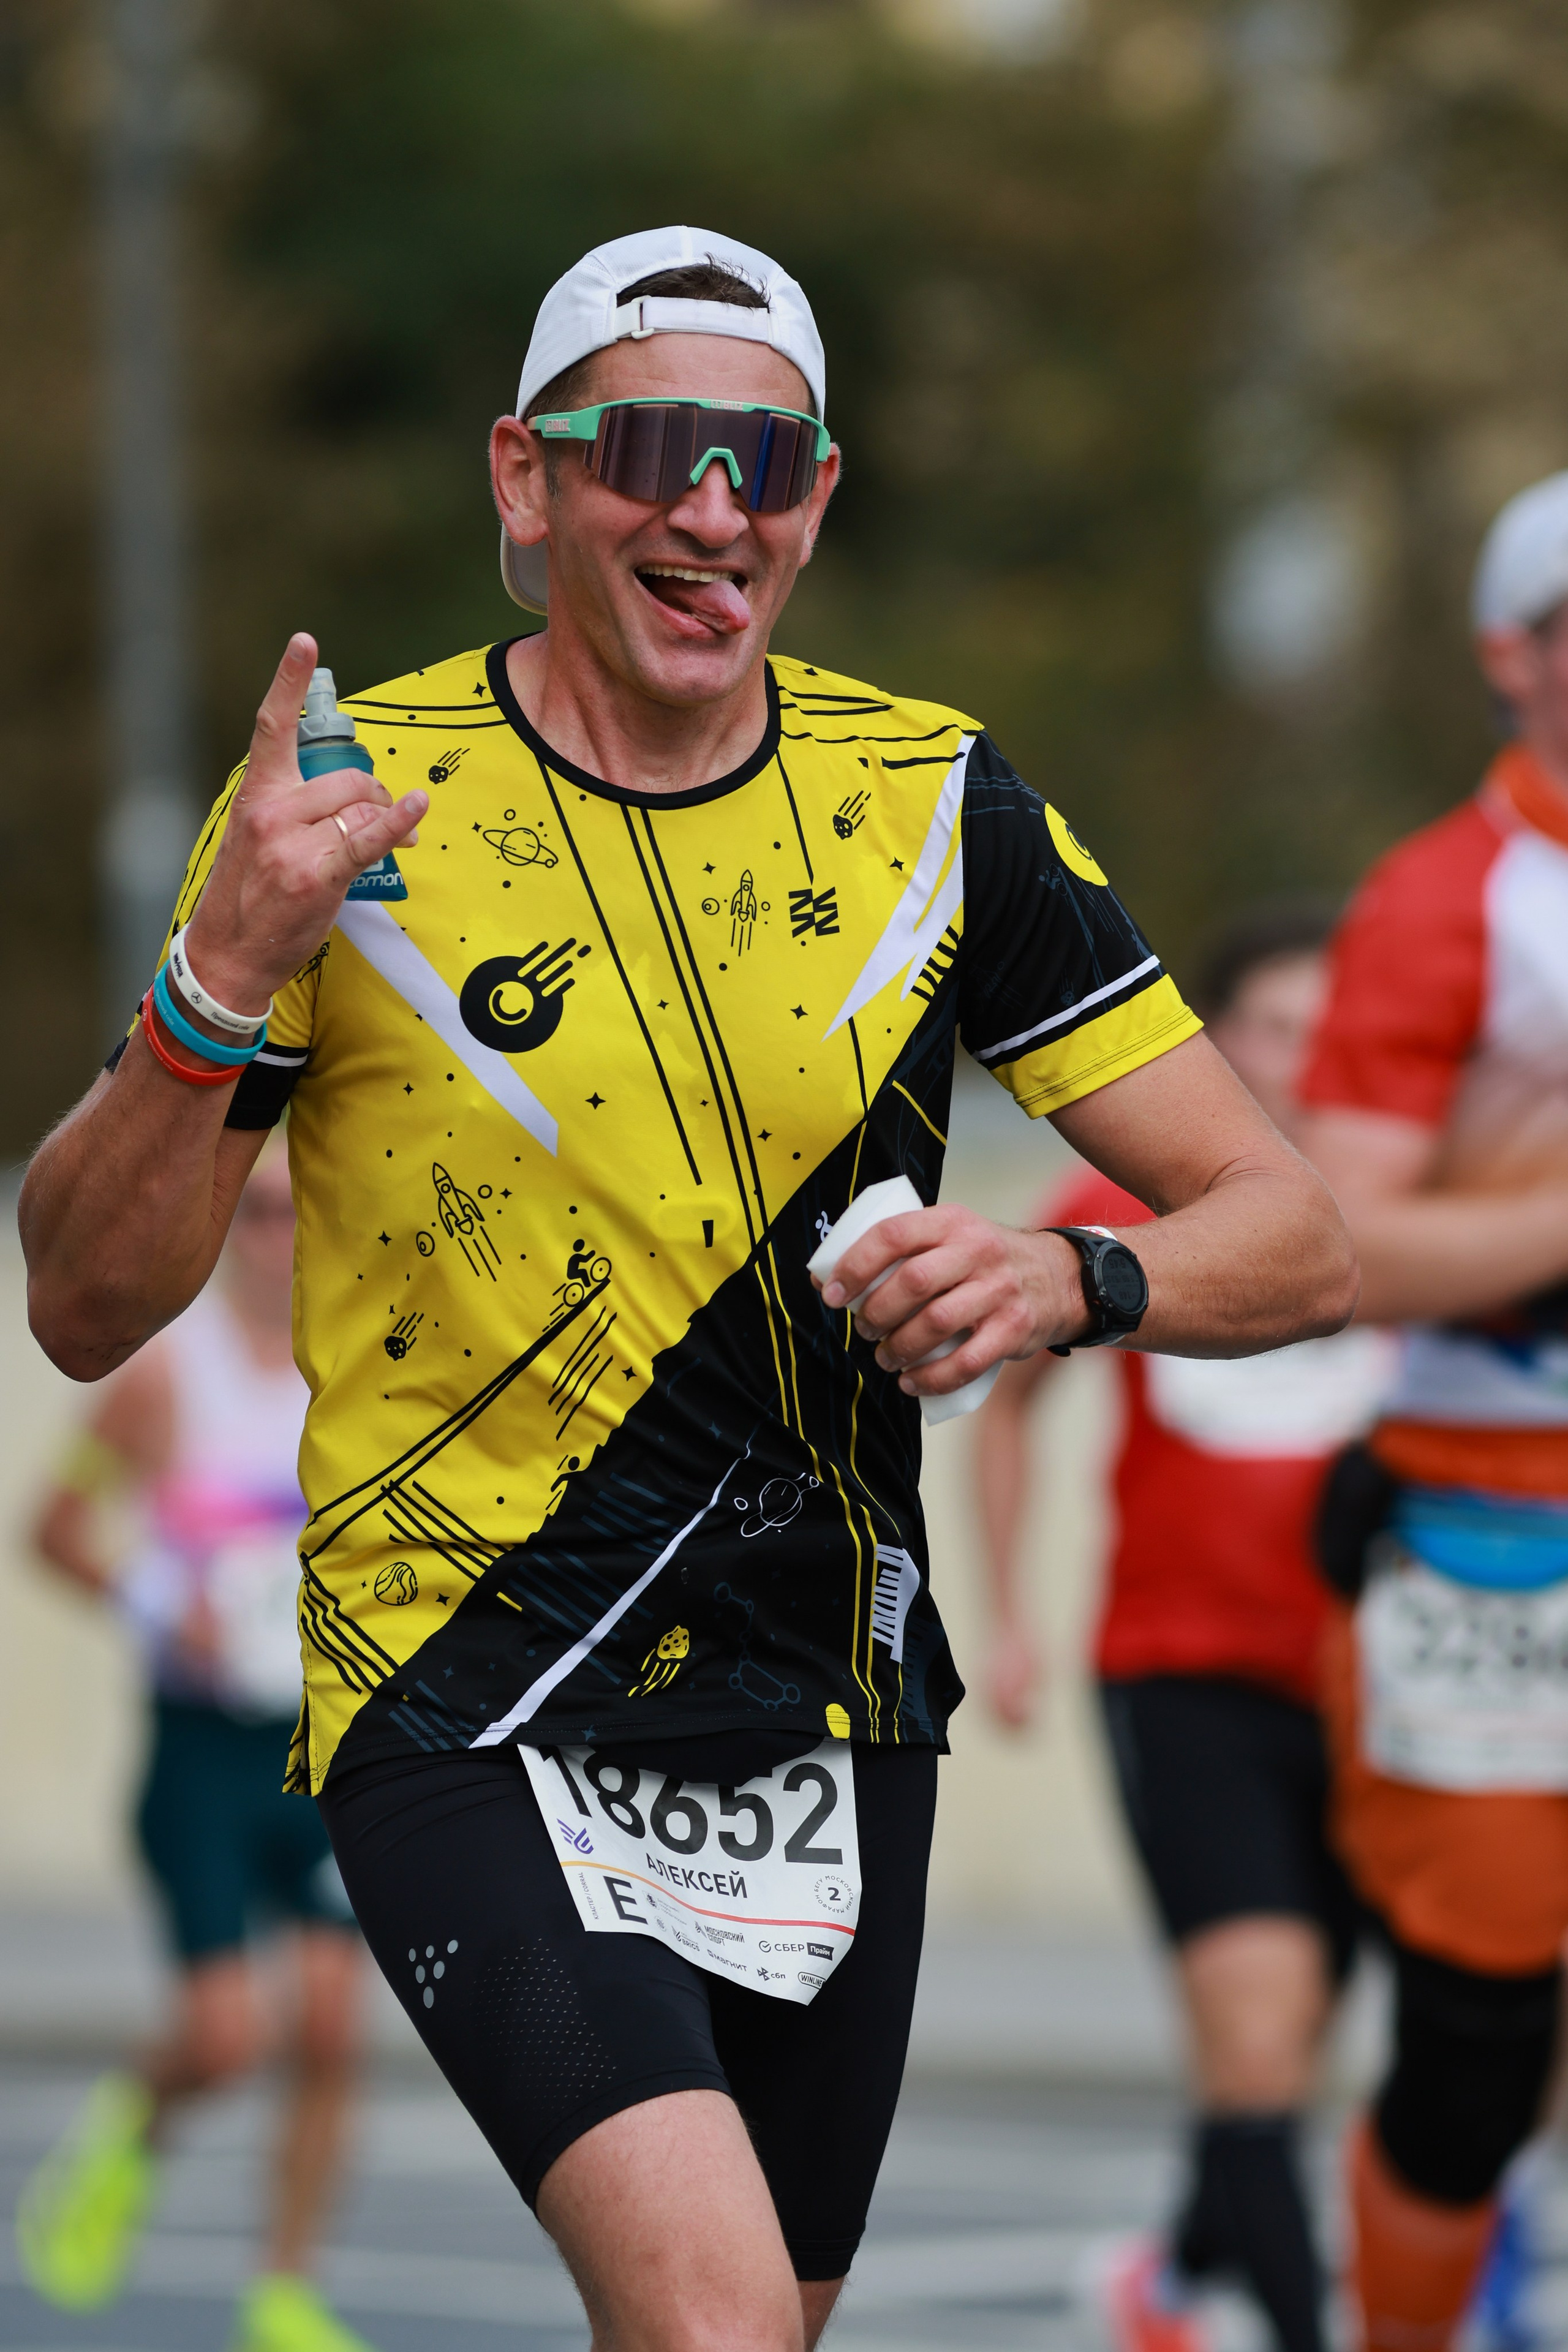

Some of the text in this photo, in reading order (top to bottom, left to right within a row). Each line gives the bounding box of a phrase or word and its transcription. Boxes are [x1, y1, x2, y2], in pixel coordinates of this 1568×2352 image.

[349, 872, 404, 888] omon
[538, 1744, 843, 1864] 18652
[578, 1872, 589, 1893] CORRAL
[646, 1852, 748, 1899] АЛЕКСЕЙ
[603, 1875, 648, 1925] E
[814, 1875, 853, 1913] БЕГУ МОСКОВСКИЙ МАРАФОН
[827, 1887, 841, 1901] 2
[586, 1896, 599, 1920] КЛАСТЕР
[704, 1925, 745, 1943] МОСКОВСКИЙ
[707, 1934, 726, 1946] СПОРТ
[682, 1939, 700, 1952] BRICS
[774, 1943, 830, 1956] СБЕР Прайм
[714, 1953, 747, 1972] магнит
[801, 1974, 823, 1987] WINLINE
